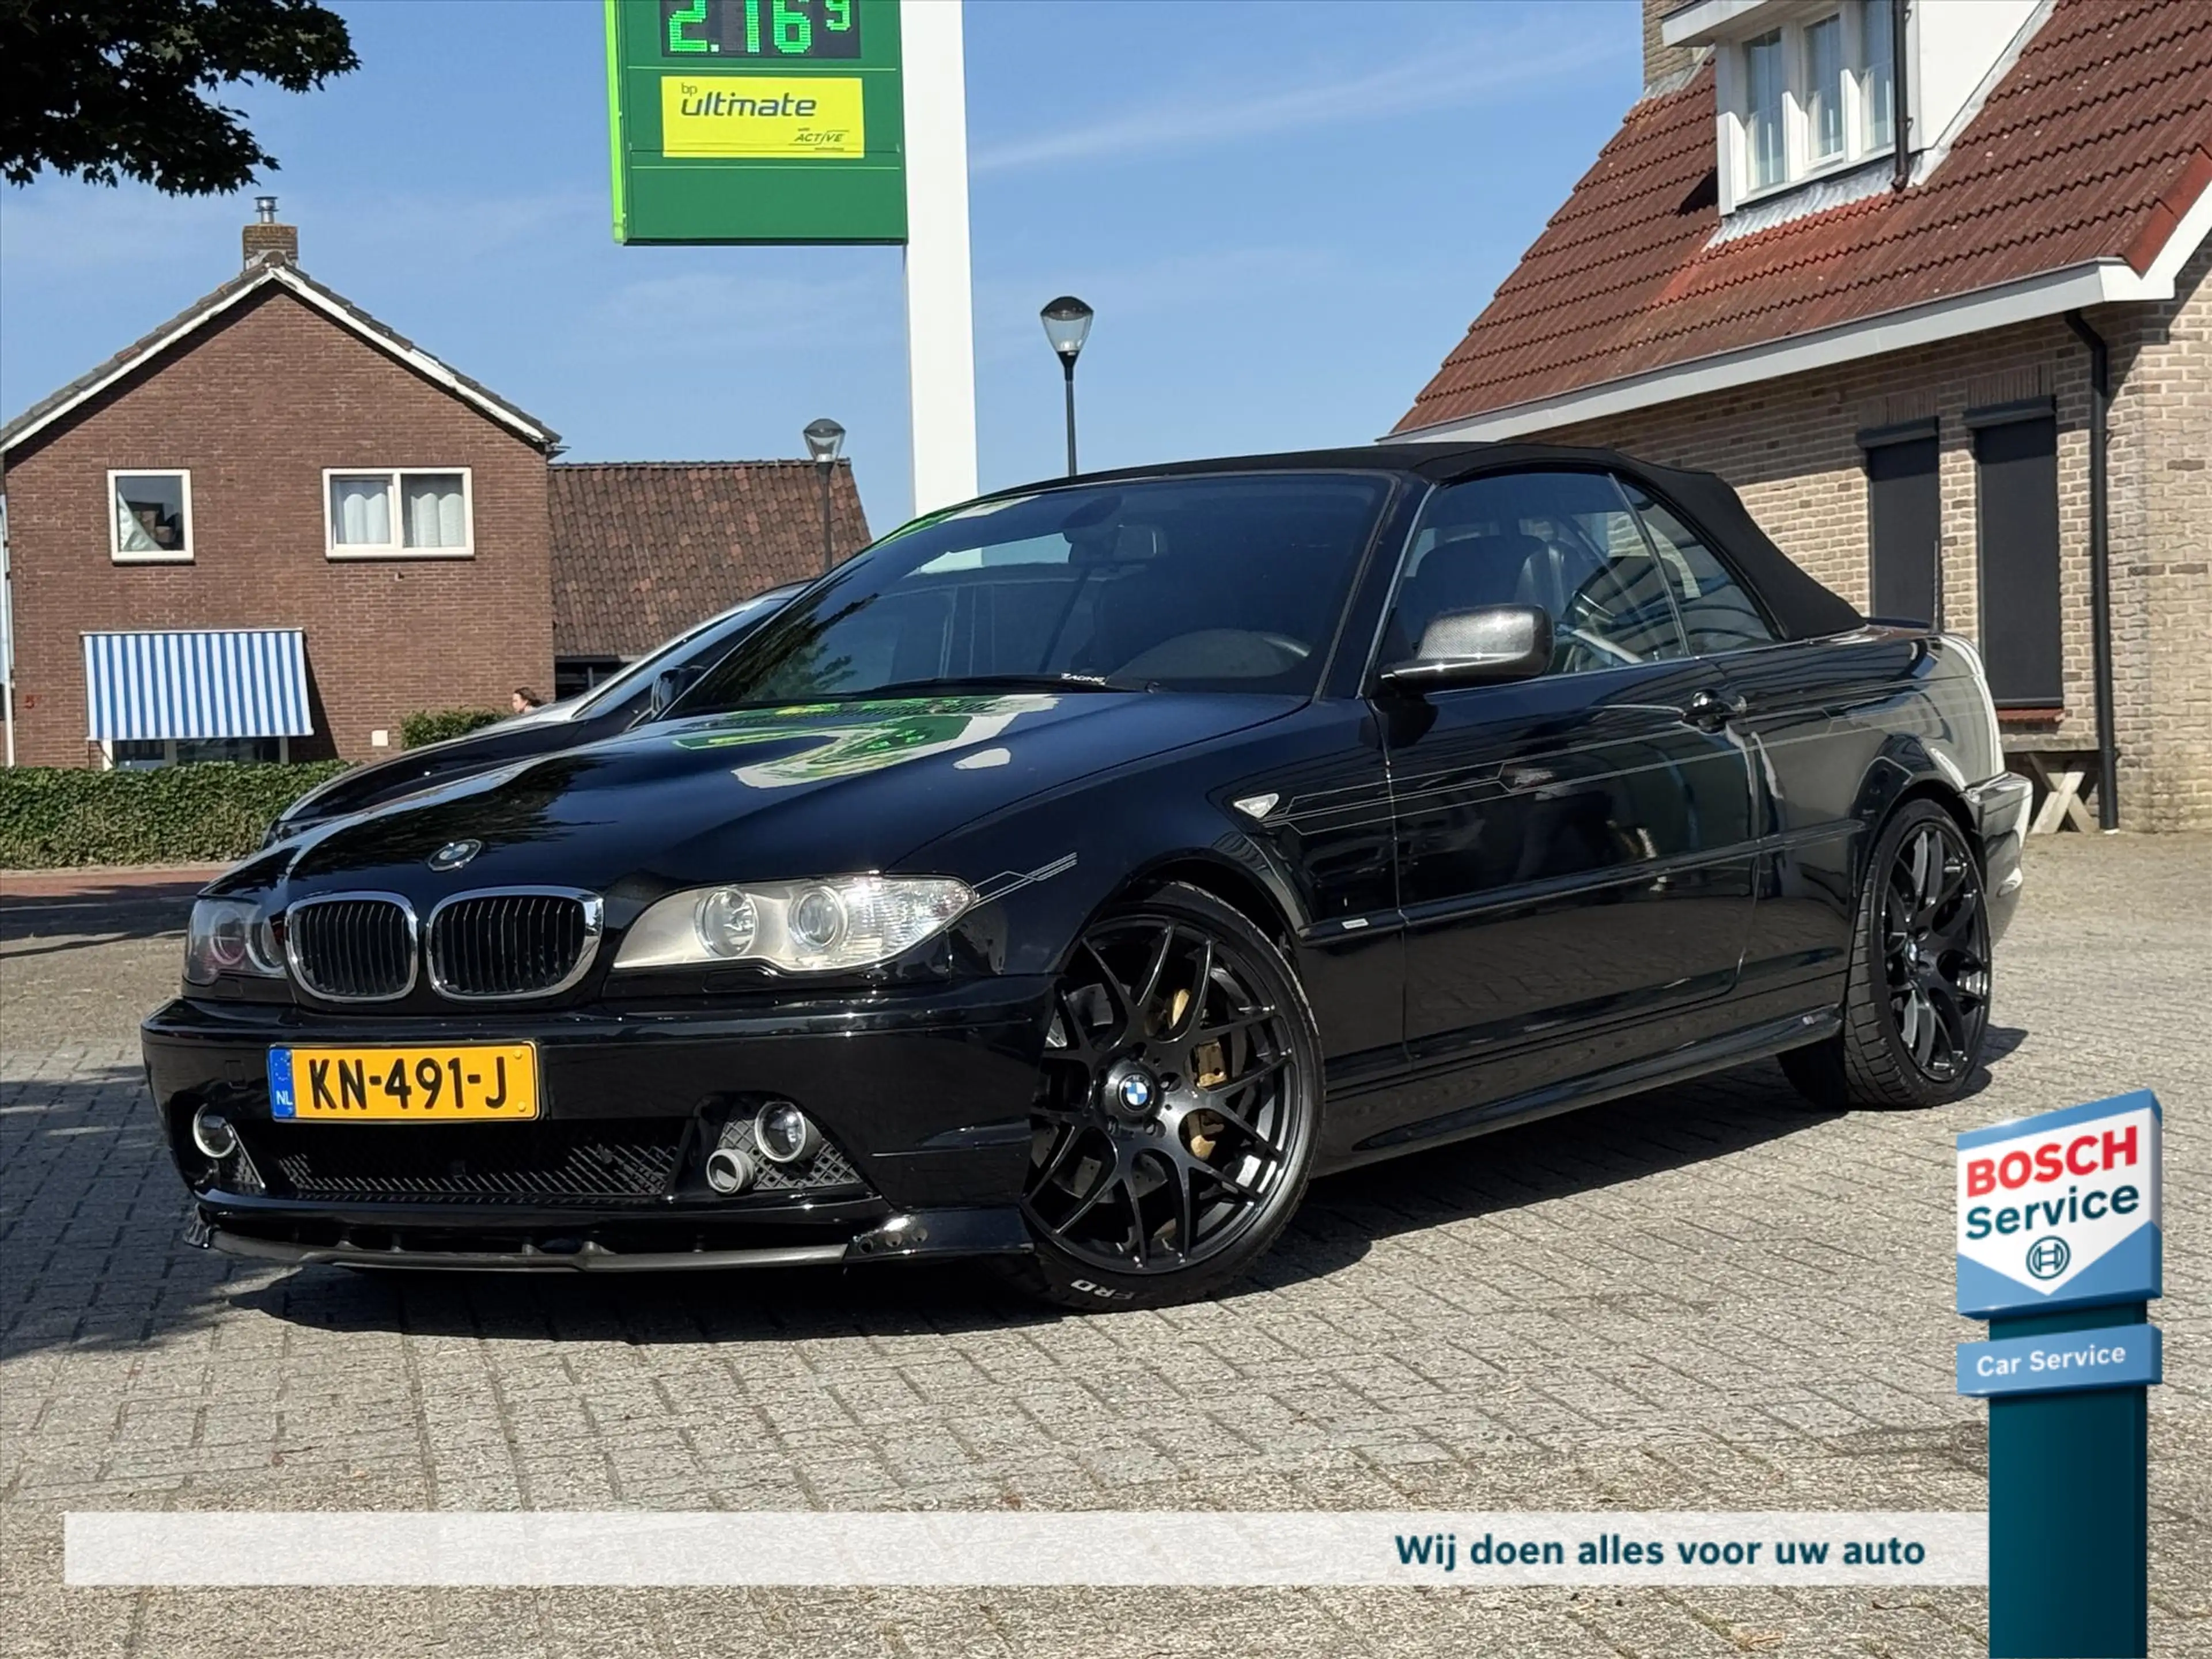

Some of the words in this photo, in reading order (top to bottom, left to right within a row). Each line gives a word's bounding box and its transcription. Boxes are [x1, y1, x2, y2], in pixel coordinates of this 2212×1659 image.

[681, 82, 698, 97] bp
[681, 92, 817, 116] ultimate
[309, 1056, 507, 1111] KN-491-J
[276, 1090, 293, 1105] NL
